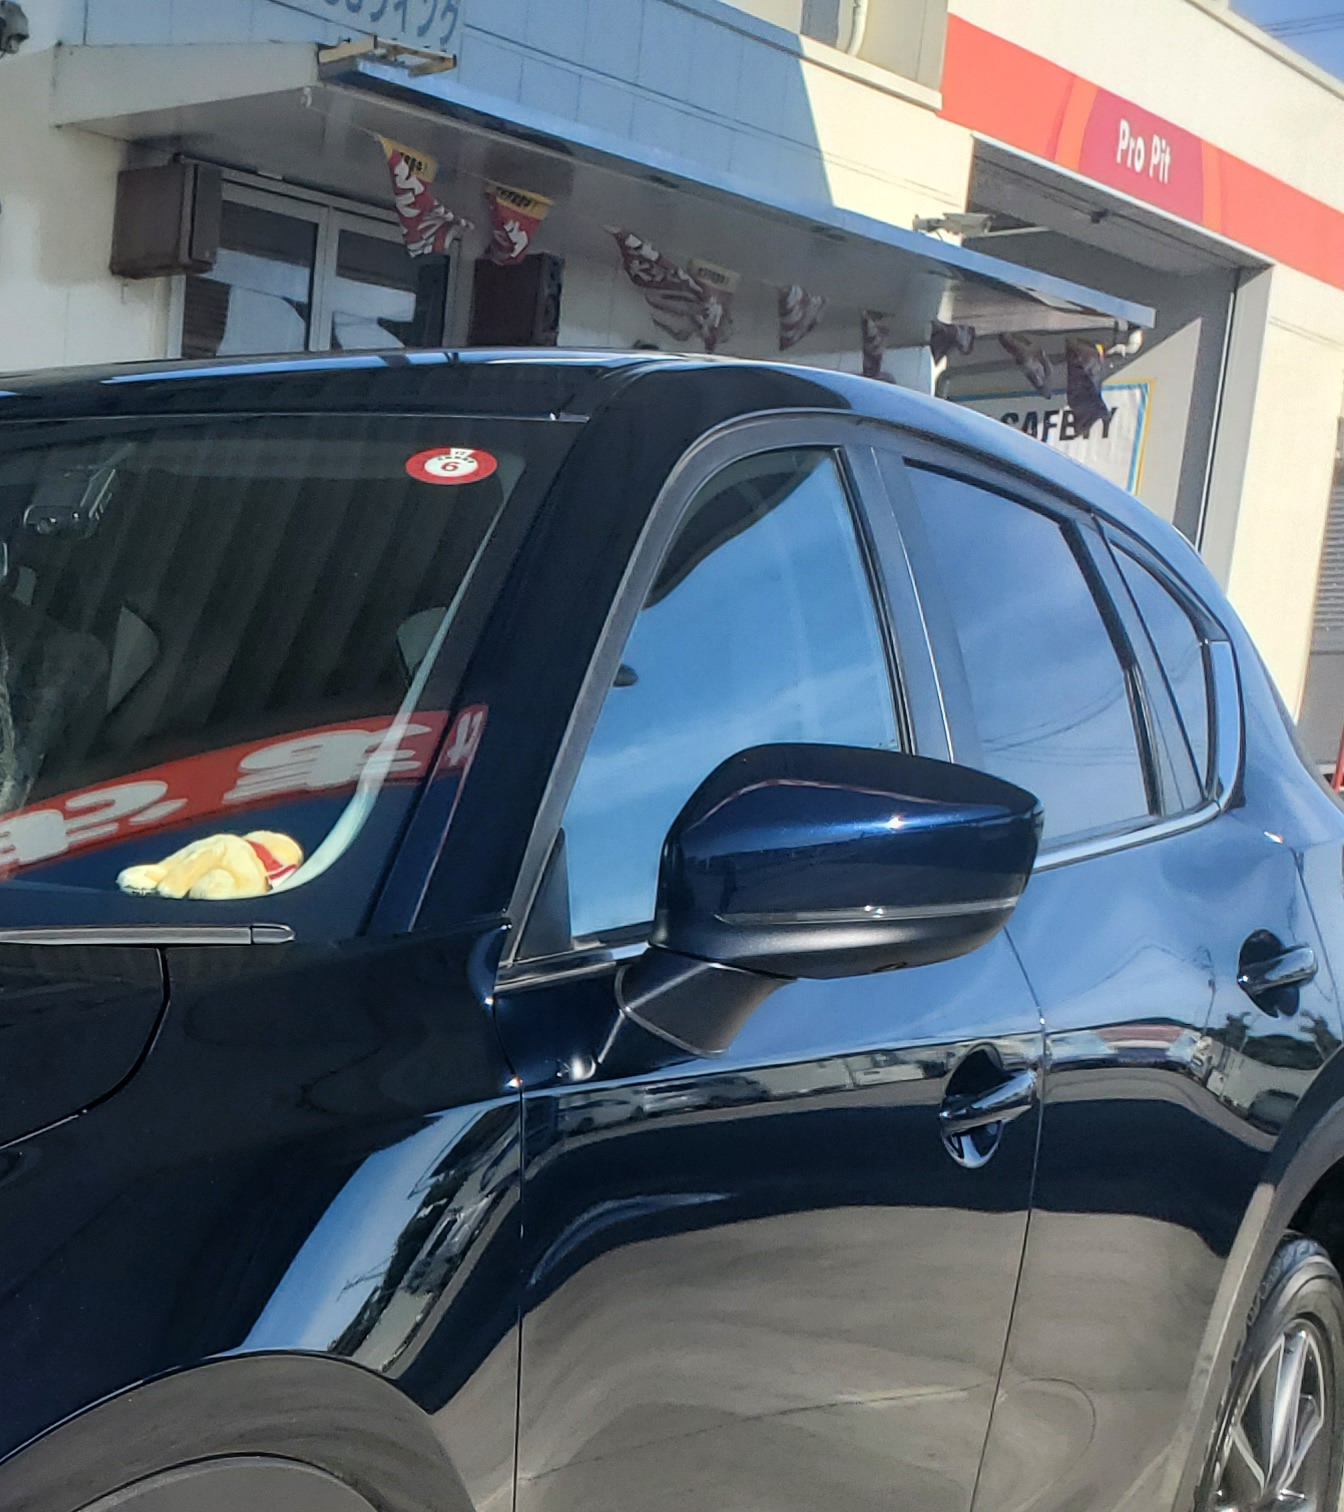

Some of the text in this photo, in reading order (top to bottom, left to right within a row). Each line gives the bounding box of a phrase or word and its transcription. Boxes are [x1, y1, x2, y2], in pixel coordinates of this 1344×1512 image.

[1116, 118, 1171, 184] Pro Pit
[441, 461, 460, 472] 6
